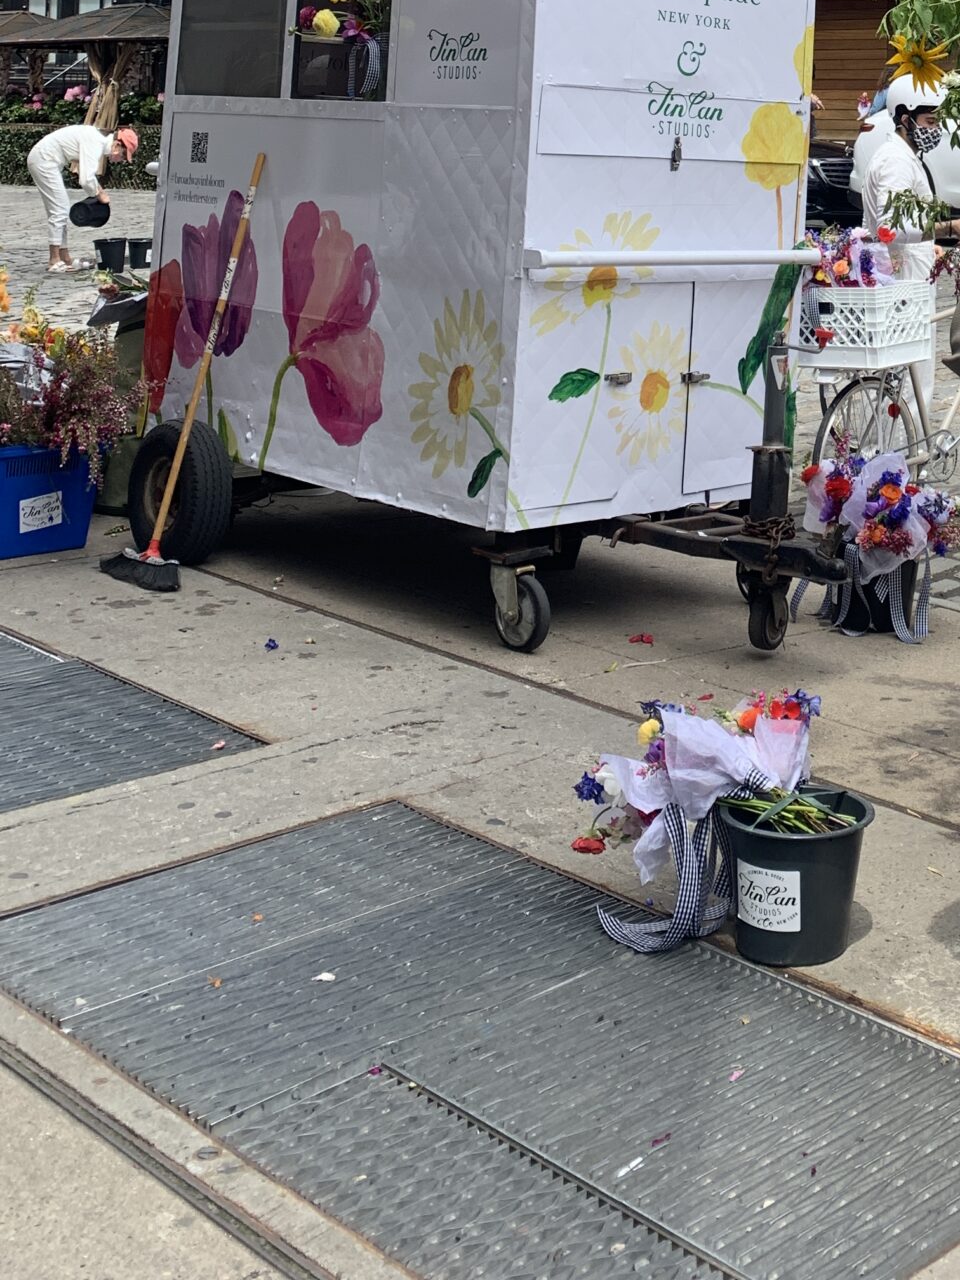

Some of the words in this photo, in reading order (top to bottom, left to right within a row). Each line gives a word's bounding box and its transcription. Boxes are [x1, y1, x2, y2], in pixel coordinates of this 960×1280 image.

[658, 10, 690, 24] NEW
[695, 14, 731, 30] YORK
[677, 40, 706, 77] &
[750, 902, 782, 917] STUDIOS
